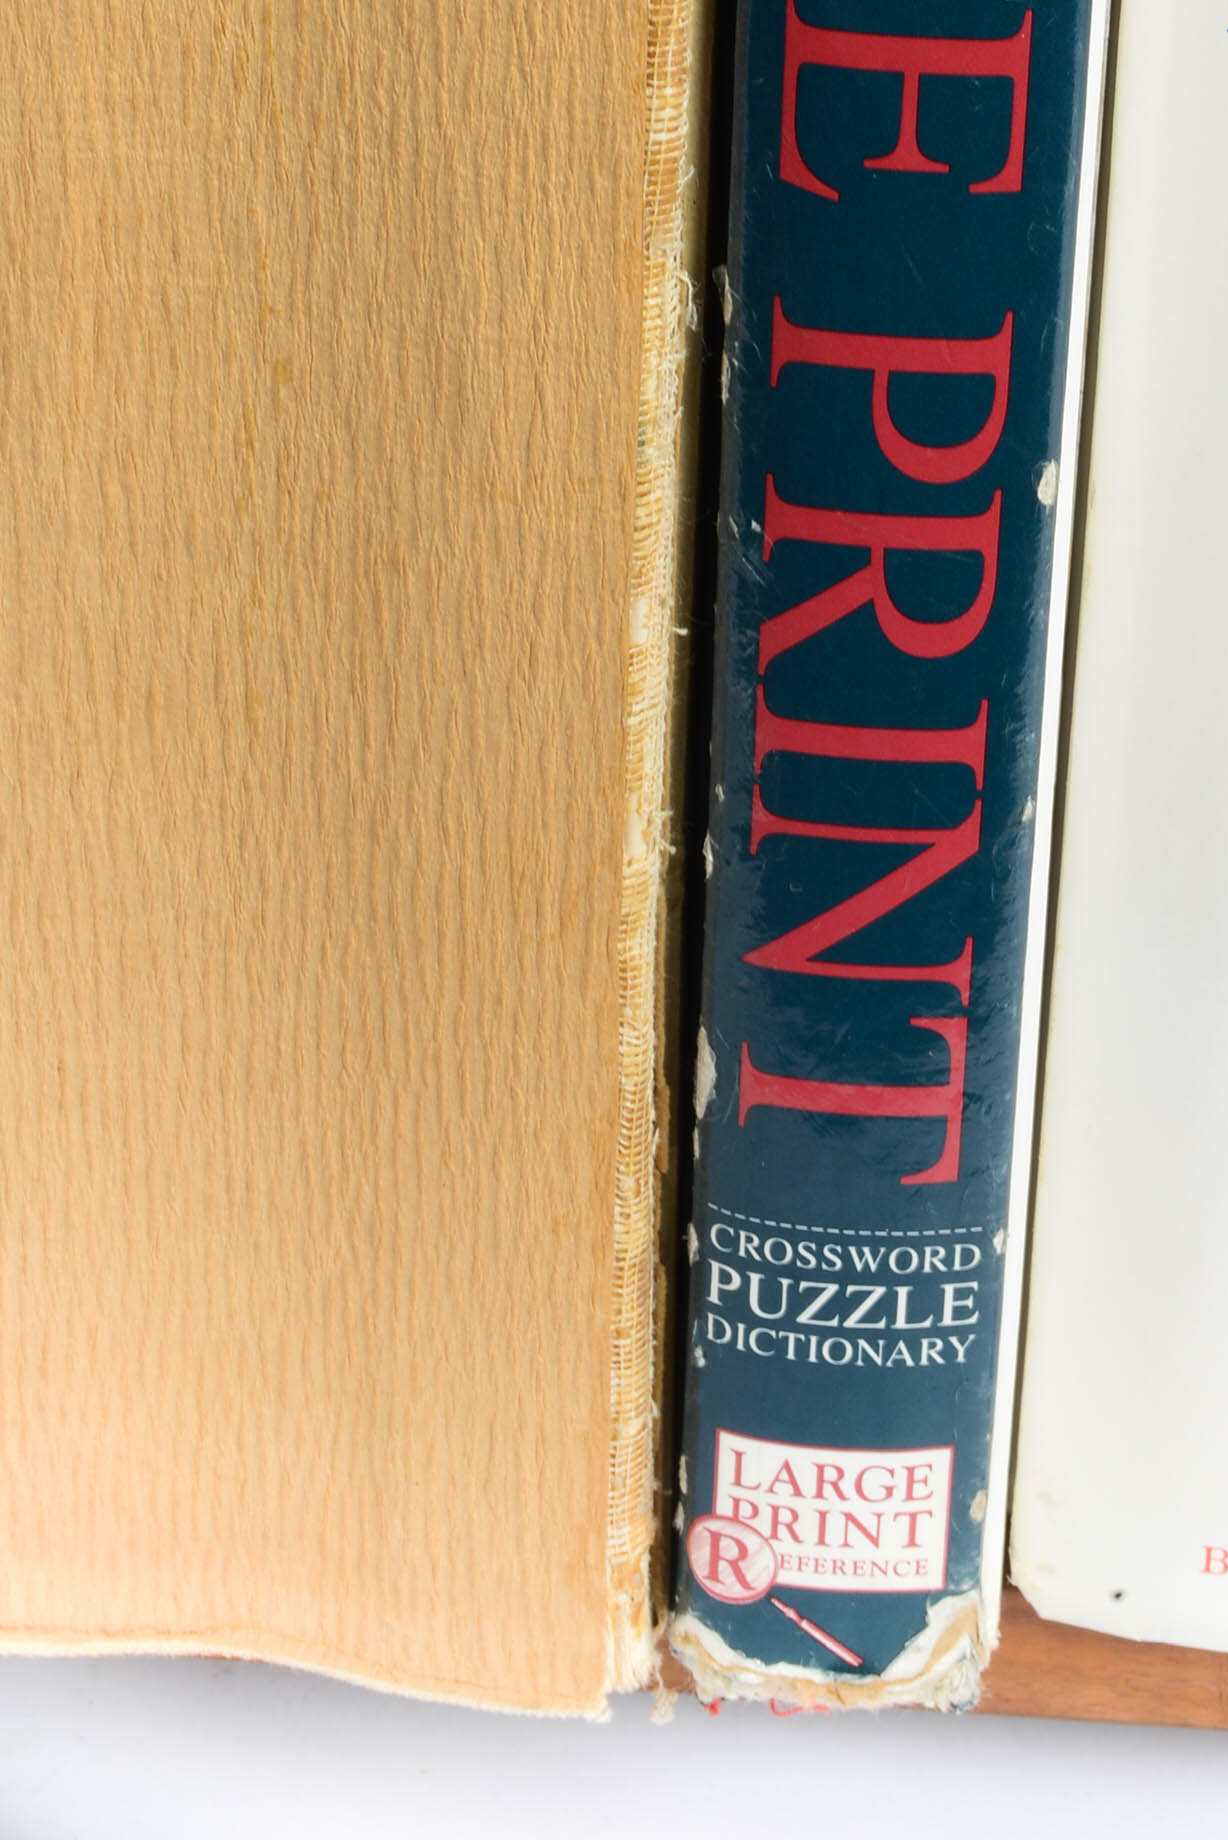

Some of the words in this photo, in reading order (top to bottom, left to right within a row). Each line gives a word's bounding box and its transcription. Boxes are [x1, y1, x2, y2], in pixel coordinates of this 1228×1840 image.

[738, 294, 1014, 1186] PRINT
[710, 1223, 982, 1275] CROSSWORD
[706, 1259, 980, 1330] PUZZLE
[705, 1313, 976, 1367] DICTIONARY
[729, 1448, 934, 1503] LARGE
[728, 1495, 934, 1550] PRINT
